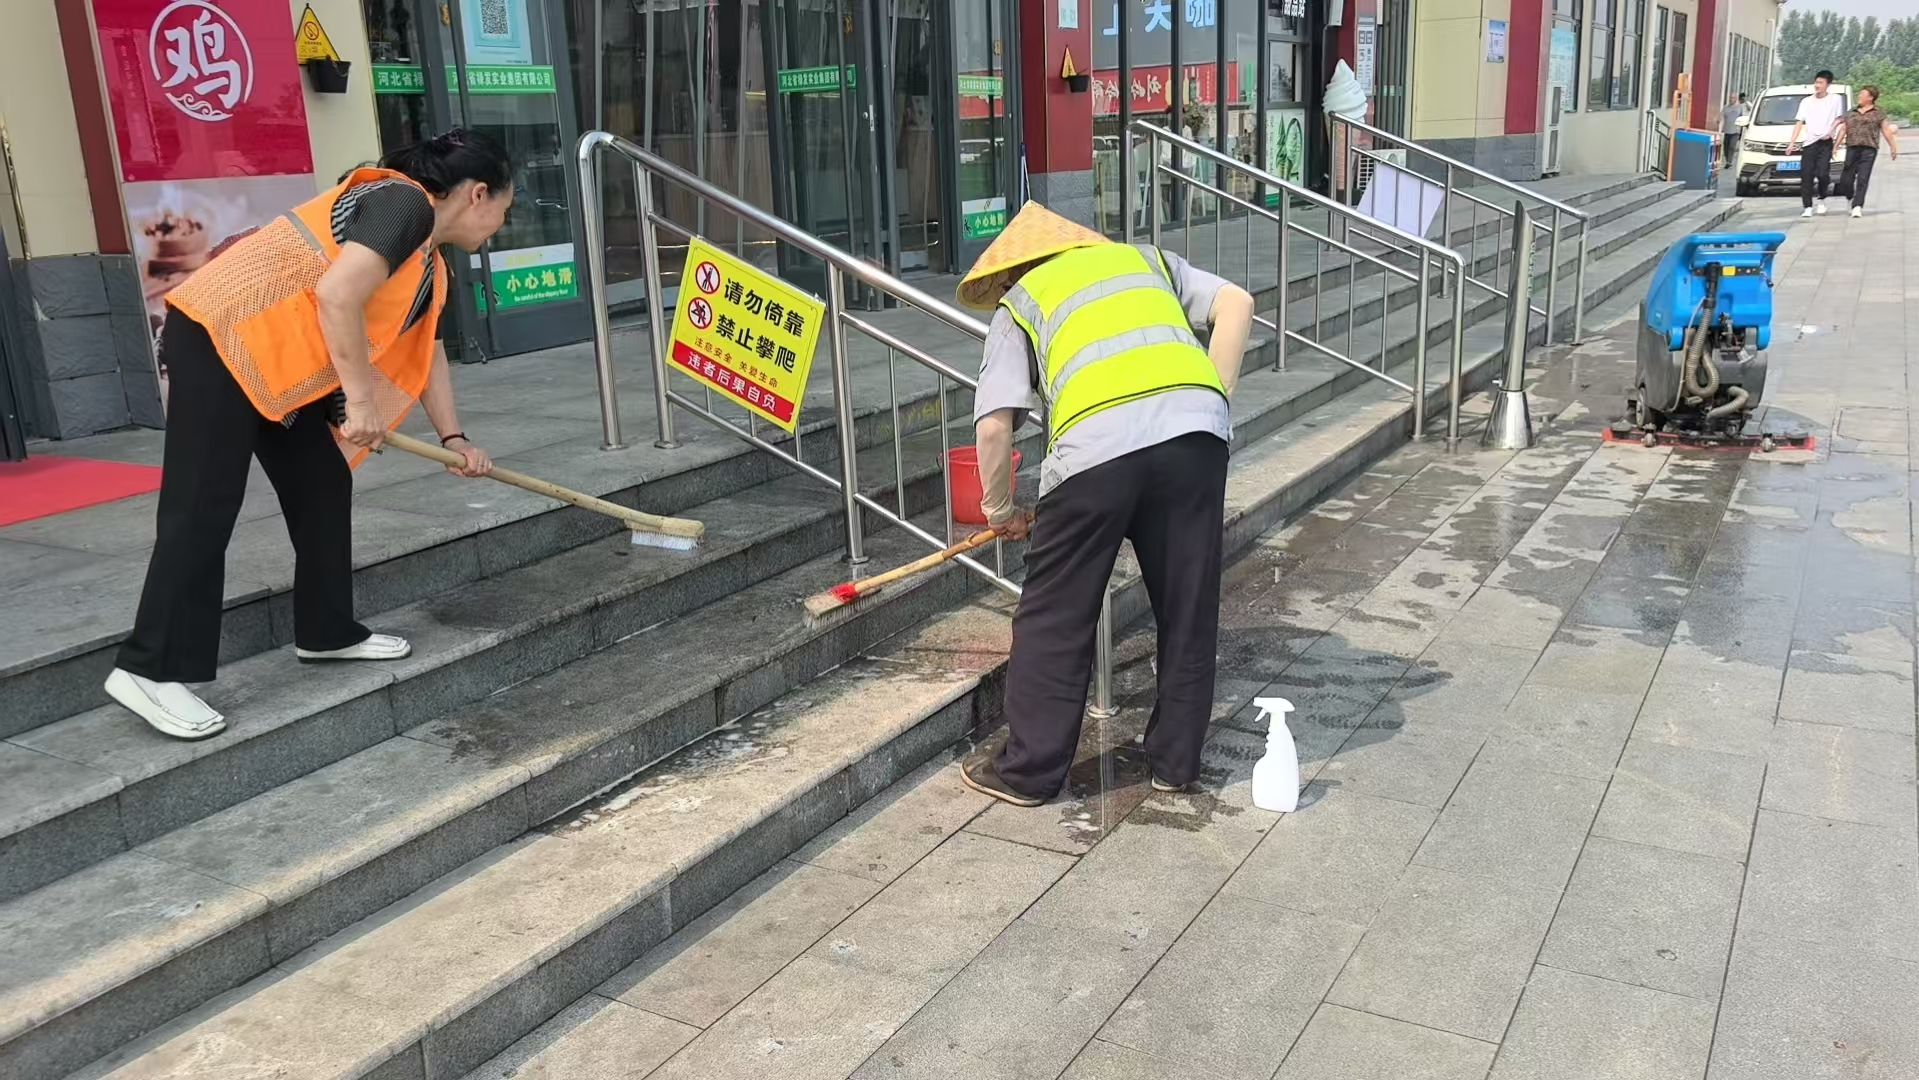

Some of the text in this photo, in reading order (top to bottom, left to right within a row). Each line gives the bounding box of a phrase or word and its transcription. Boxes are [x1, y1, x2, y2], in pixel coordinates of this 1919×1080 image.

[161, 9, 242, 109] 鸡
[453, 71, 551, 86] 河省禄发实业集团有限公司
[506, 267, 572, 293] 小心地滑
[723, 278, 805, 338] 请勿倚靠
[694, 337, 778, 388] 注意安全 关爱生命
[716, 313, 797, 373] 禁止攀爬
[687, 351, 776, 412] 违者后果自负
